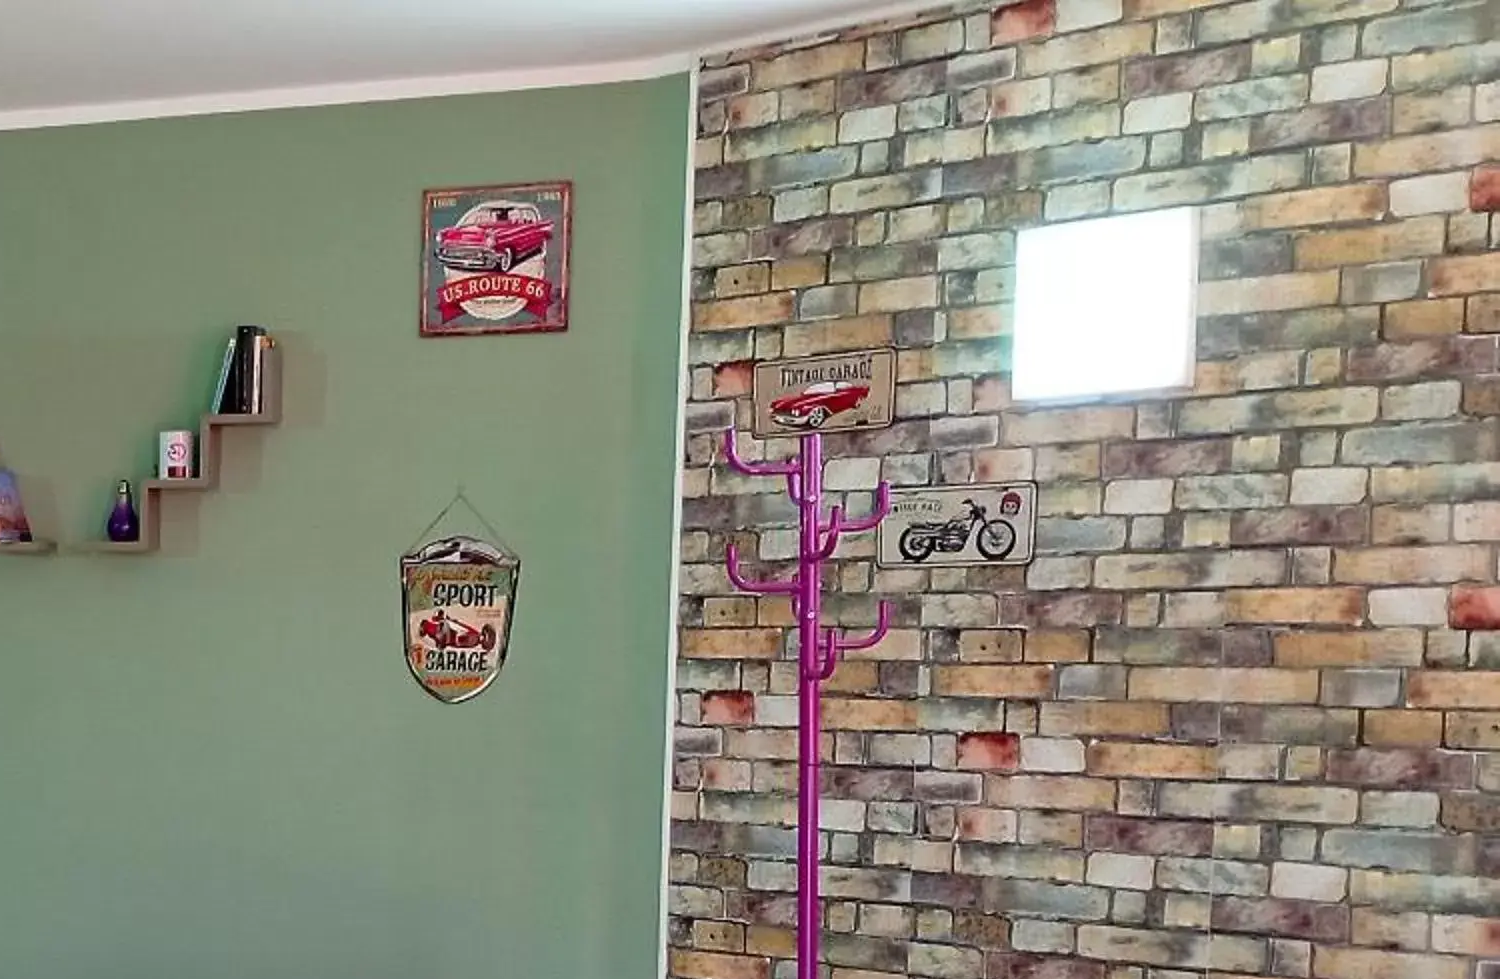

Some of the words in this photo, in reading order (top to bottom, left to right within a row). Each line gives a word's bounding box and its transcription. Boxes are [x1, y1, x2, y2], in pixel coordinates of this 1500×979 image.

[525, 279, 545, 298] 66
[781, 367, 825, 387] VINTAGE
[829, 358, 874, 380] GARAGE
[433, 583, 499, 608] SPORT
[425, 649, 489, 672] GARAGE
